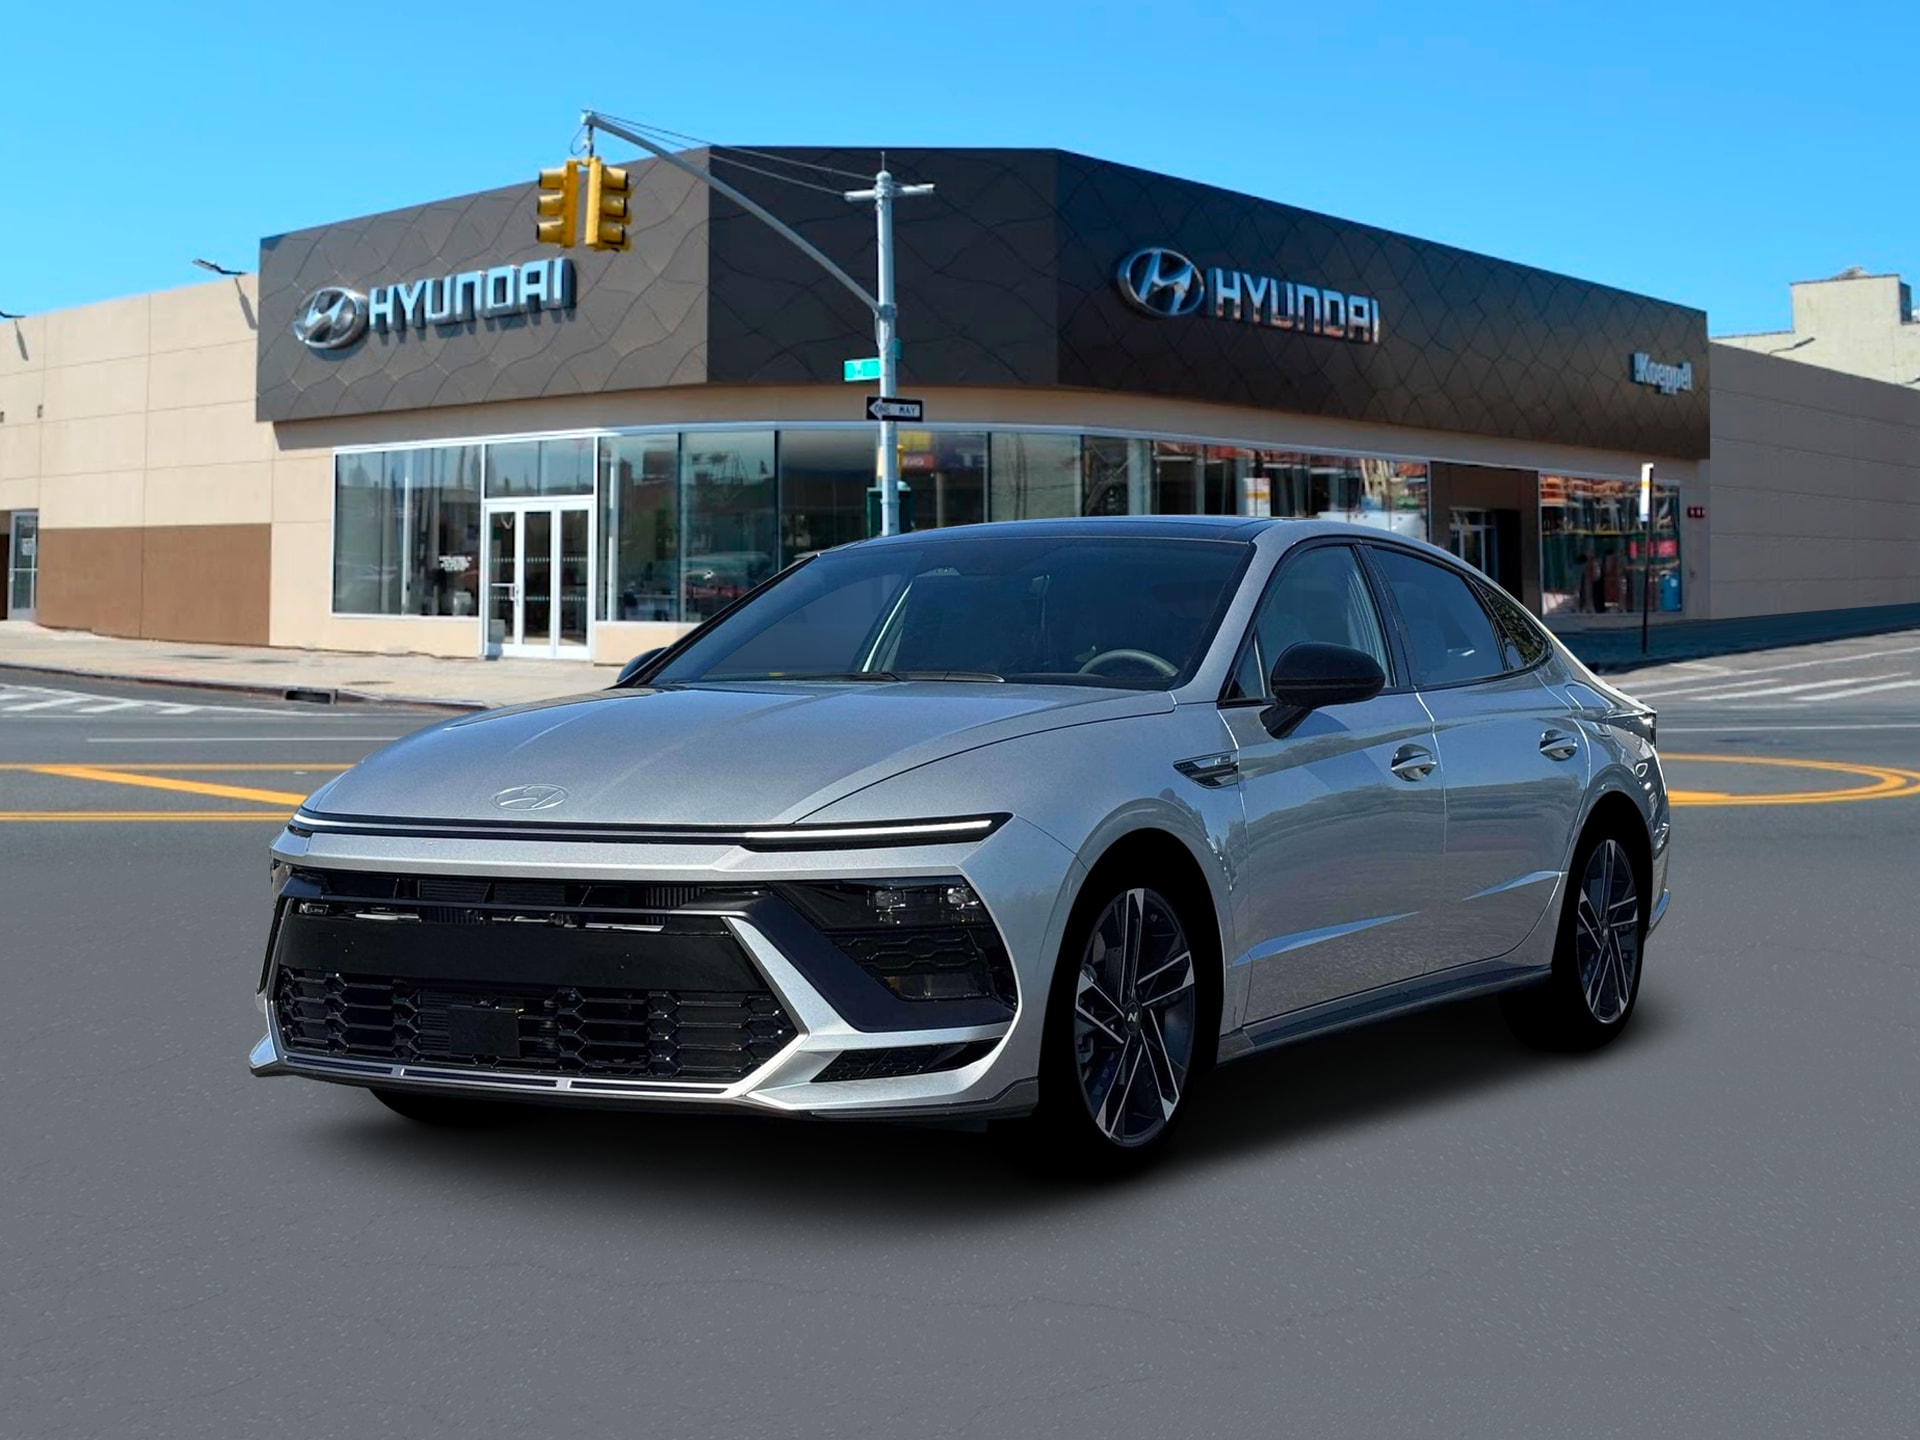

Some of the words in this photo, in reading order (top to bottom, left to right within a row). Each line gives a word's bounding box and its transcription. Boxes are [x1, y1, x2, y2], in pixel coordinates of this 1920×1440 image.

[369, 257, 571, 329] HYUNDAI
[1214, 267, 1381, 344] HYUNDAI
[1633, 352, 1692, 395] Koeppel
[874, 403, 891, 415] ONE
[898, 404, 917, 416] WAY
[1127, 1012, 1138, 1022] N
